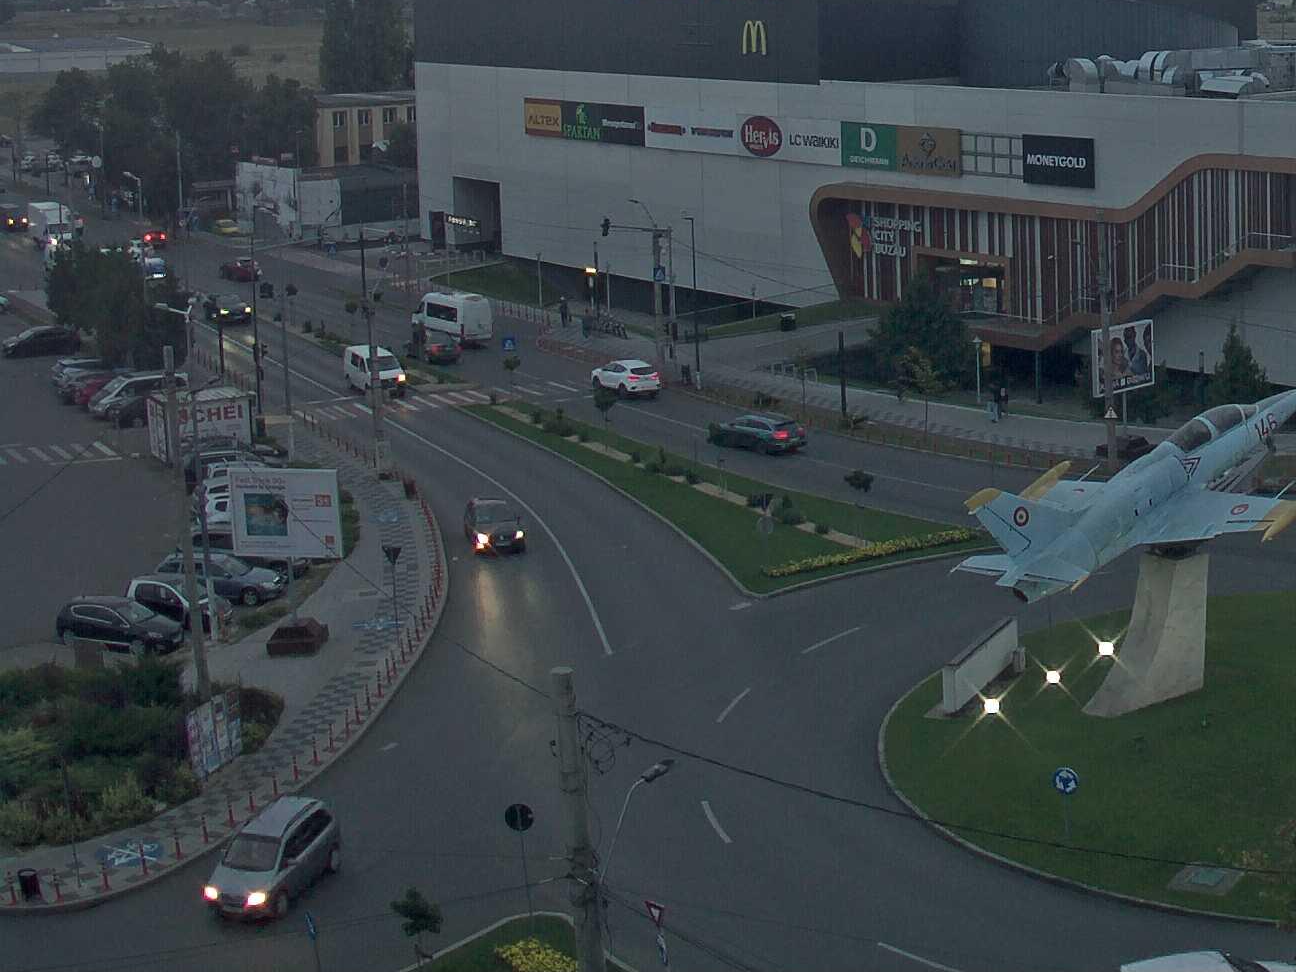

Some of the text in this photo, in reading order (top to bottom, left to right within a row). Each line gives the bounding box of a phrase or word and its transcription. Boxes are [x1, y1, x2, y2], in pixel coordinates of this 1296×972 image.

[745, 125, 779, 149] Hervis
[789, 133, 801, 146] LC
[861, 127, 877, 152] D
[1026, 153, 1087, 169] MONEYGOLD
[872, 218, 922, 232] SHOPPING
[875, 231, 894, 242] CITY
